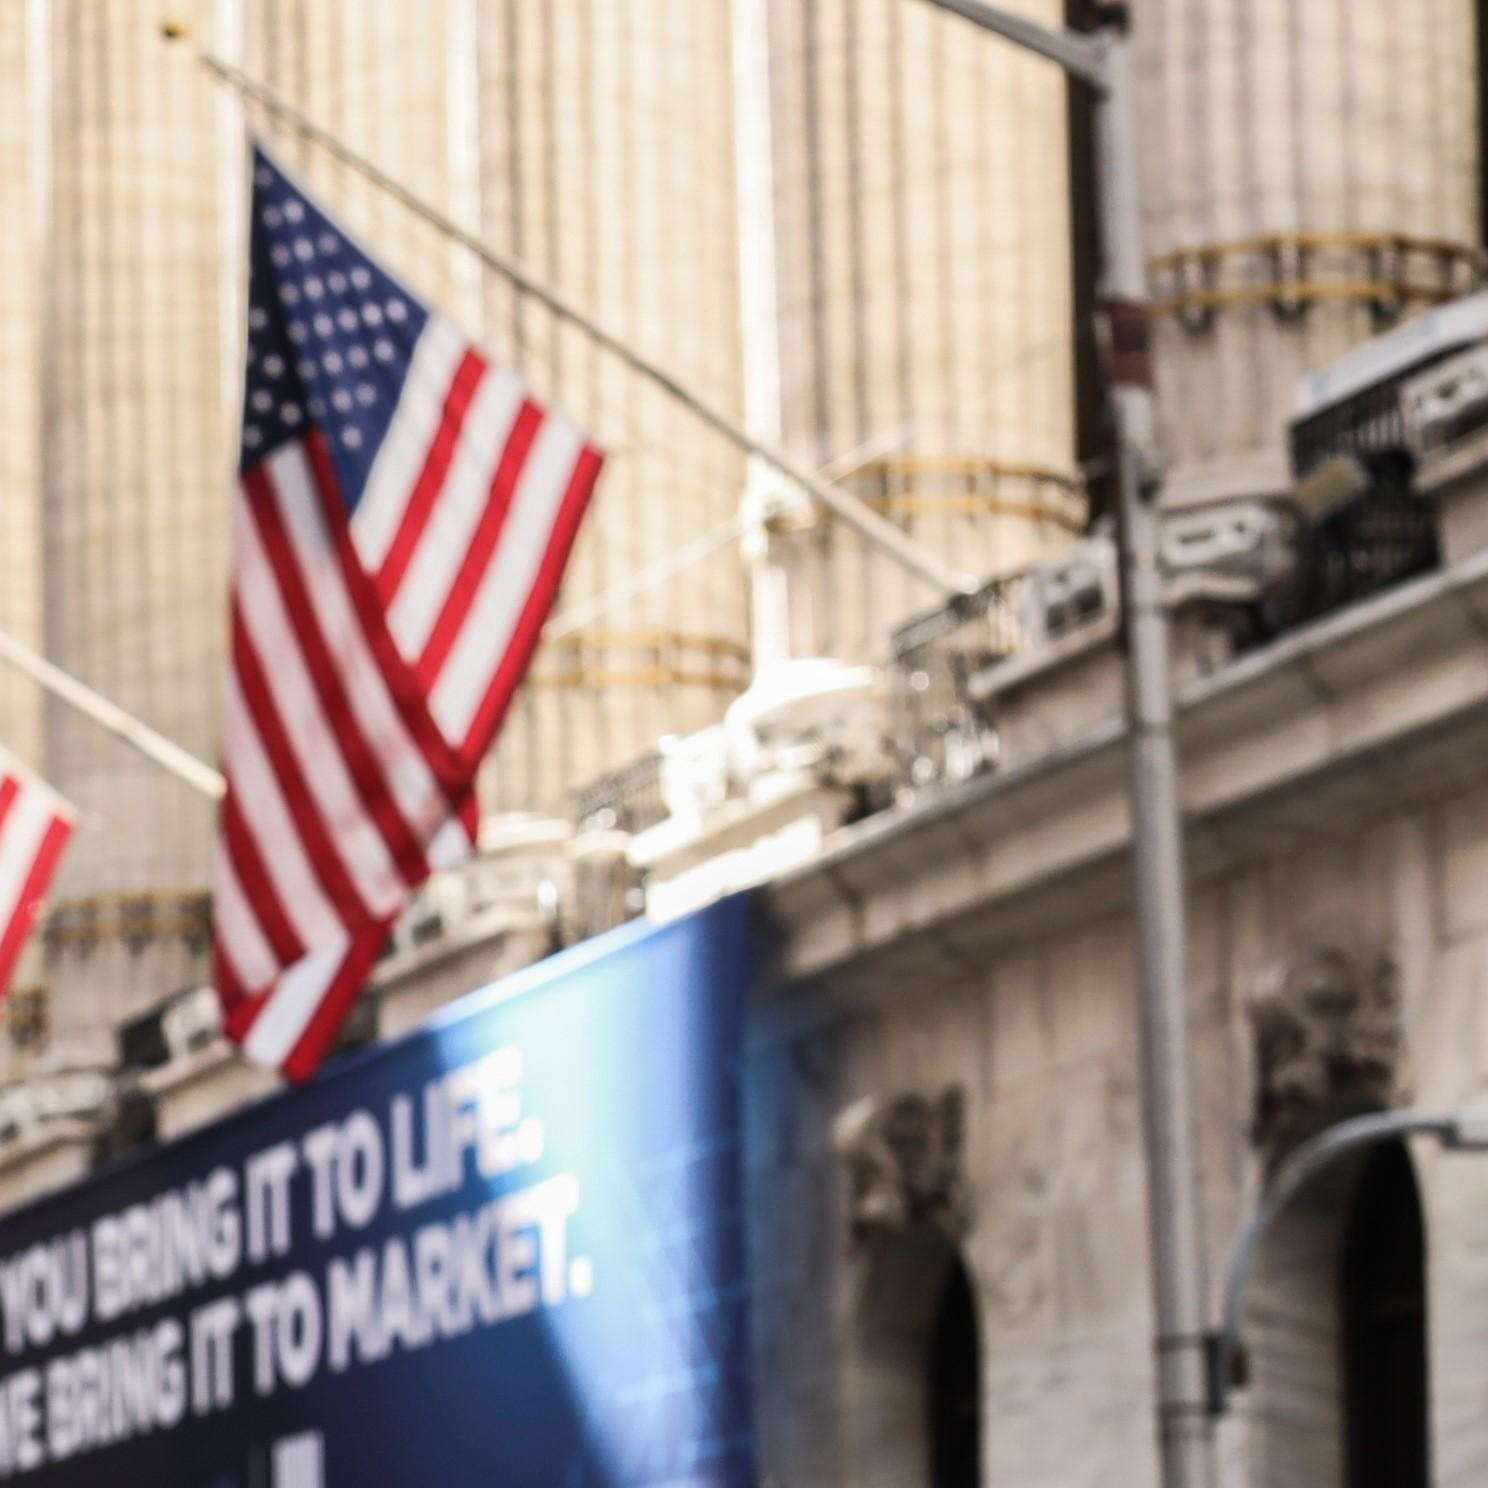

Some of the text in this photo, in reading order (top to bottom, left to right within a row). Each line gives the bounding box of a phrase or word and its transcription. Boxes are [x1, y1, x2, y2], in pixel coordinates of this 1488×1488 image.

[46, 1316, 186, 1459] BRING
[189, 1296, 239, 1417] IT
[245, 1270, 322, 1395] TO
[328, 1171, 593, 1372] MARKET.
[92, 1166, 241, 1319] BRING
[246, 1142, 296, 1262] IT
[303, 1109, 385, 1239] TO
[391, 1046, 544, 1209] LIFE.
